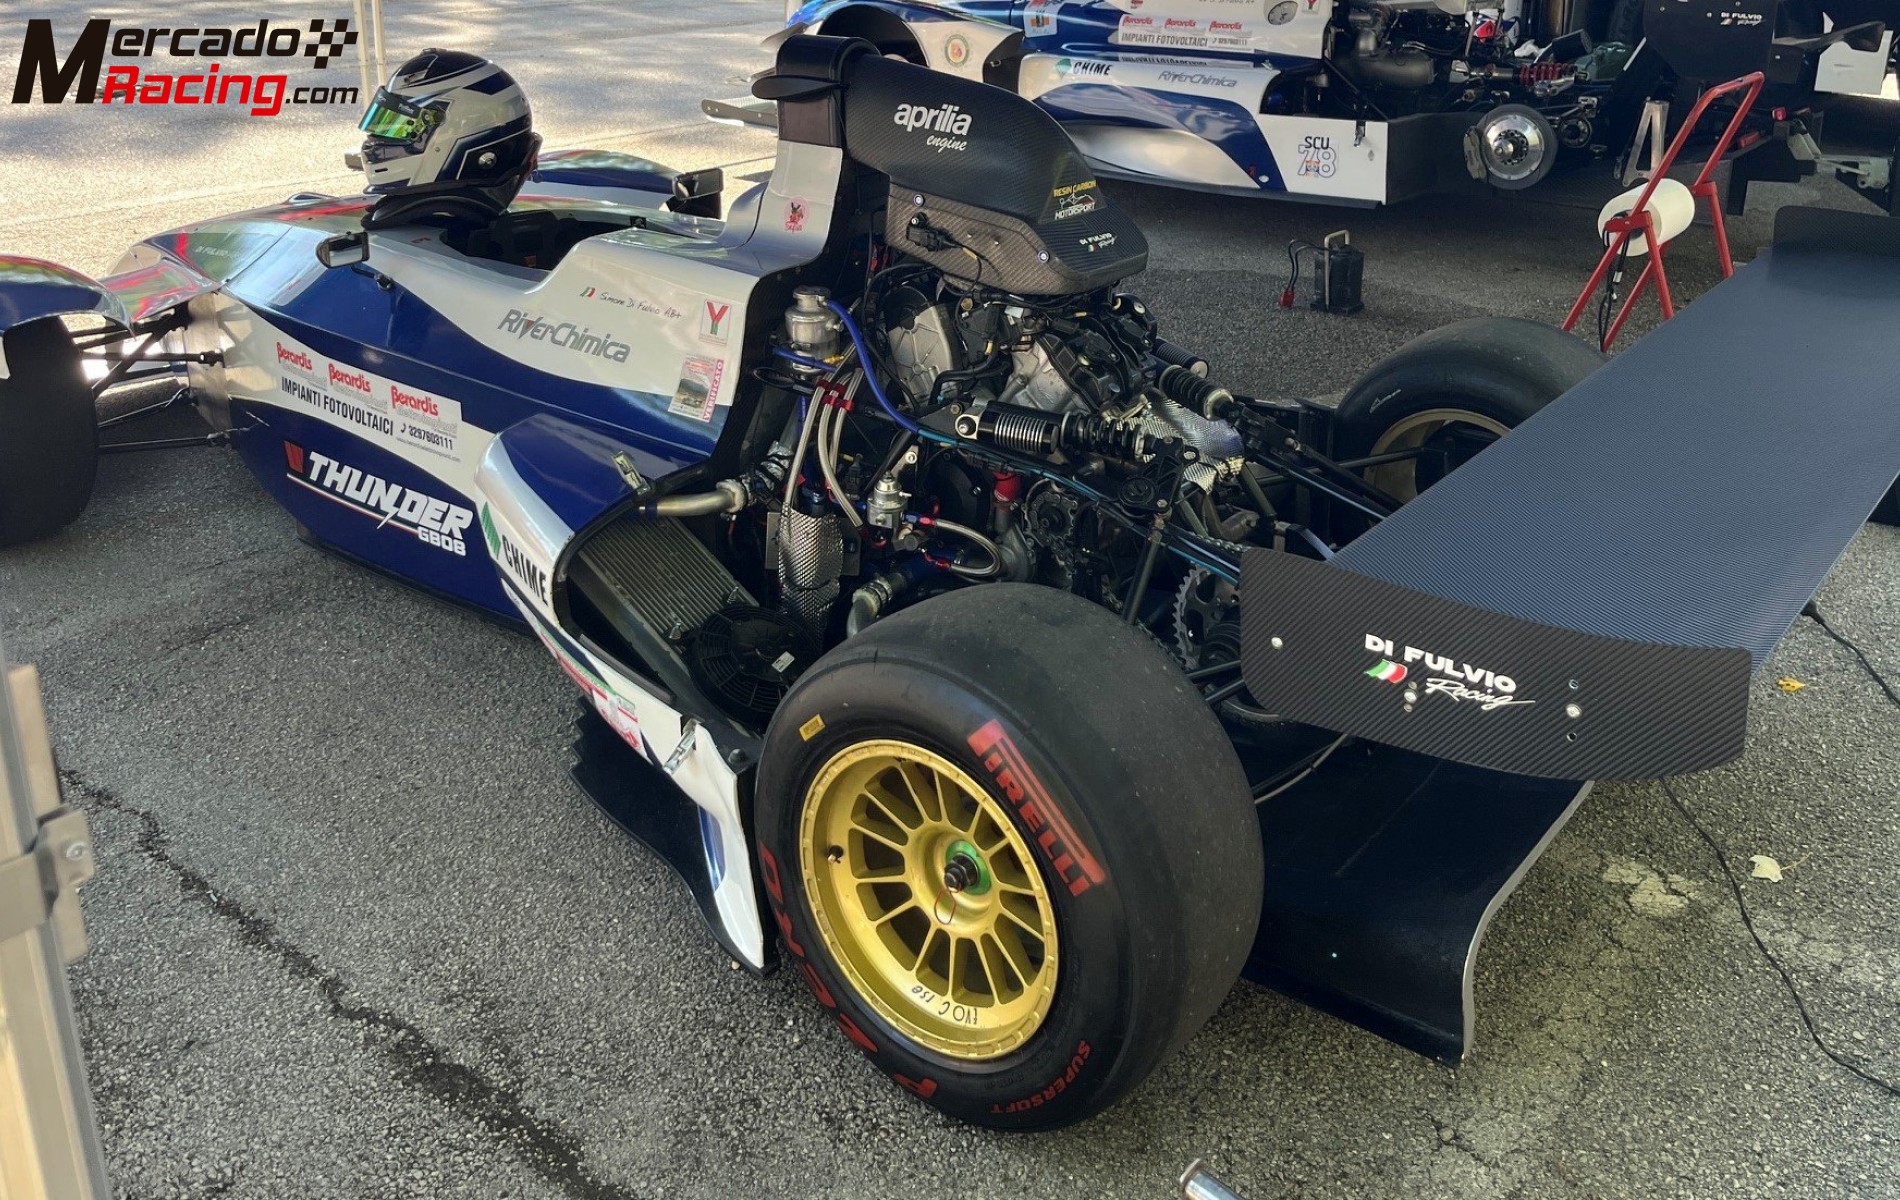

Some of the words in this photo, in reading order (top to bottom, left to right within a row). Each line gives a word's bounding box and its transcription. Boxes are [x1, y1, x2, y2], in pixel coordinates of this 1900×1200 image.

[1121, 33, 1155, 44] IMPIANTI
[1156, 34, 1208, 47] FOTOVOLTAICI
[1073, 61, 1111, 76] CHIME
[894, 102, 973, 136] aprilia
[926, 134, 968, 153] engine
[1304, 135, 1330, 150] SCU
[1053, 185, 1073, 197] RESIN
[1054, 202, 1096, 220] MOTORSPORT
[276, 341, 313, 371] Berardis
[328, 363, 372, 393] Berardis
[281, 377, 321, 408] IMPIANTI
[323, 395, 394, 436] FOTOVOLTAICI
[390, 385, 439, 417] Berardis
[309, 451, 474, 541] THUNDER
[501, 534, 548, 607] CHIME
[1365, 633, 1394, 656] DI
[1403, 645, 1517, 693] FULVIO
[1425, 677, 1536, 710] Racing
[967, 718, 1107, 897] PIRELLI
[990, 1040, 1092, 1114] SUPERSOFT
